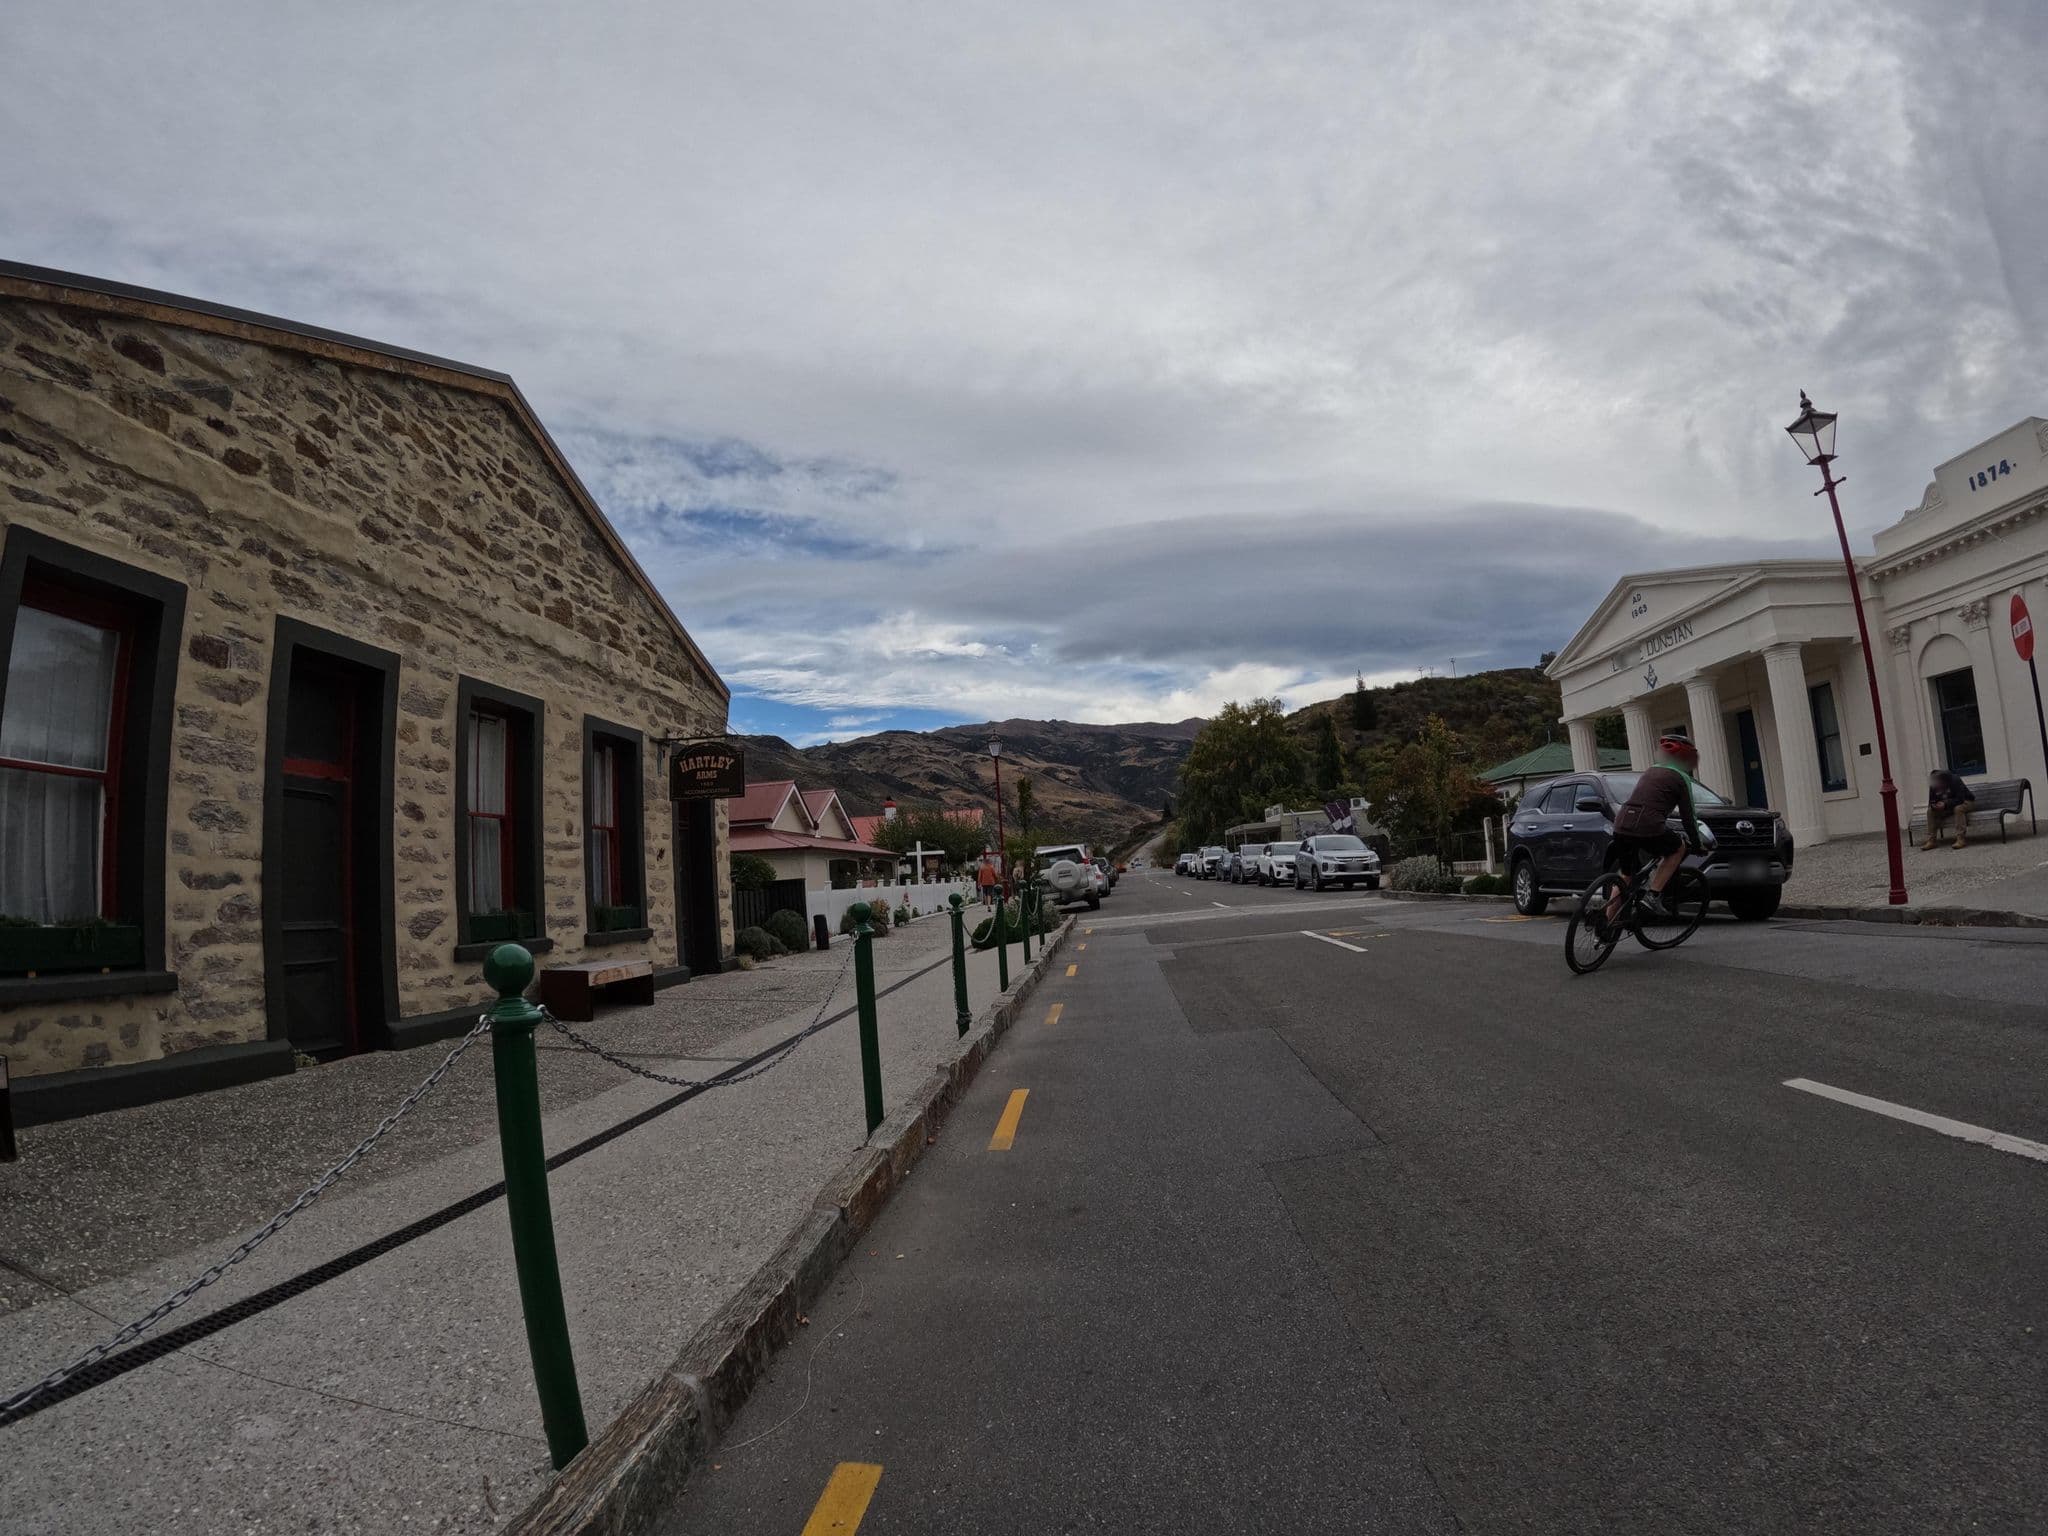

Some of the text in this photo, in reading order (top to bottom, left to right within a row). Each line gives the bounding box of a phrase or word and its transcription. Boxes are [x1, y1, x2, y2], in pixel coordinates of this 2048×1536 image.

[1633, 594, 1642, 605] AD
[1646, 620, 1693, 656] DUNSTAN
[679, 755, 735, 773] HARTLEY
[696, 770, 718, 779] ARMS
